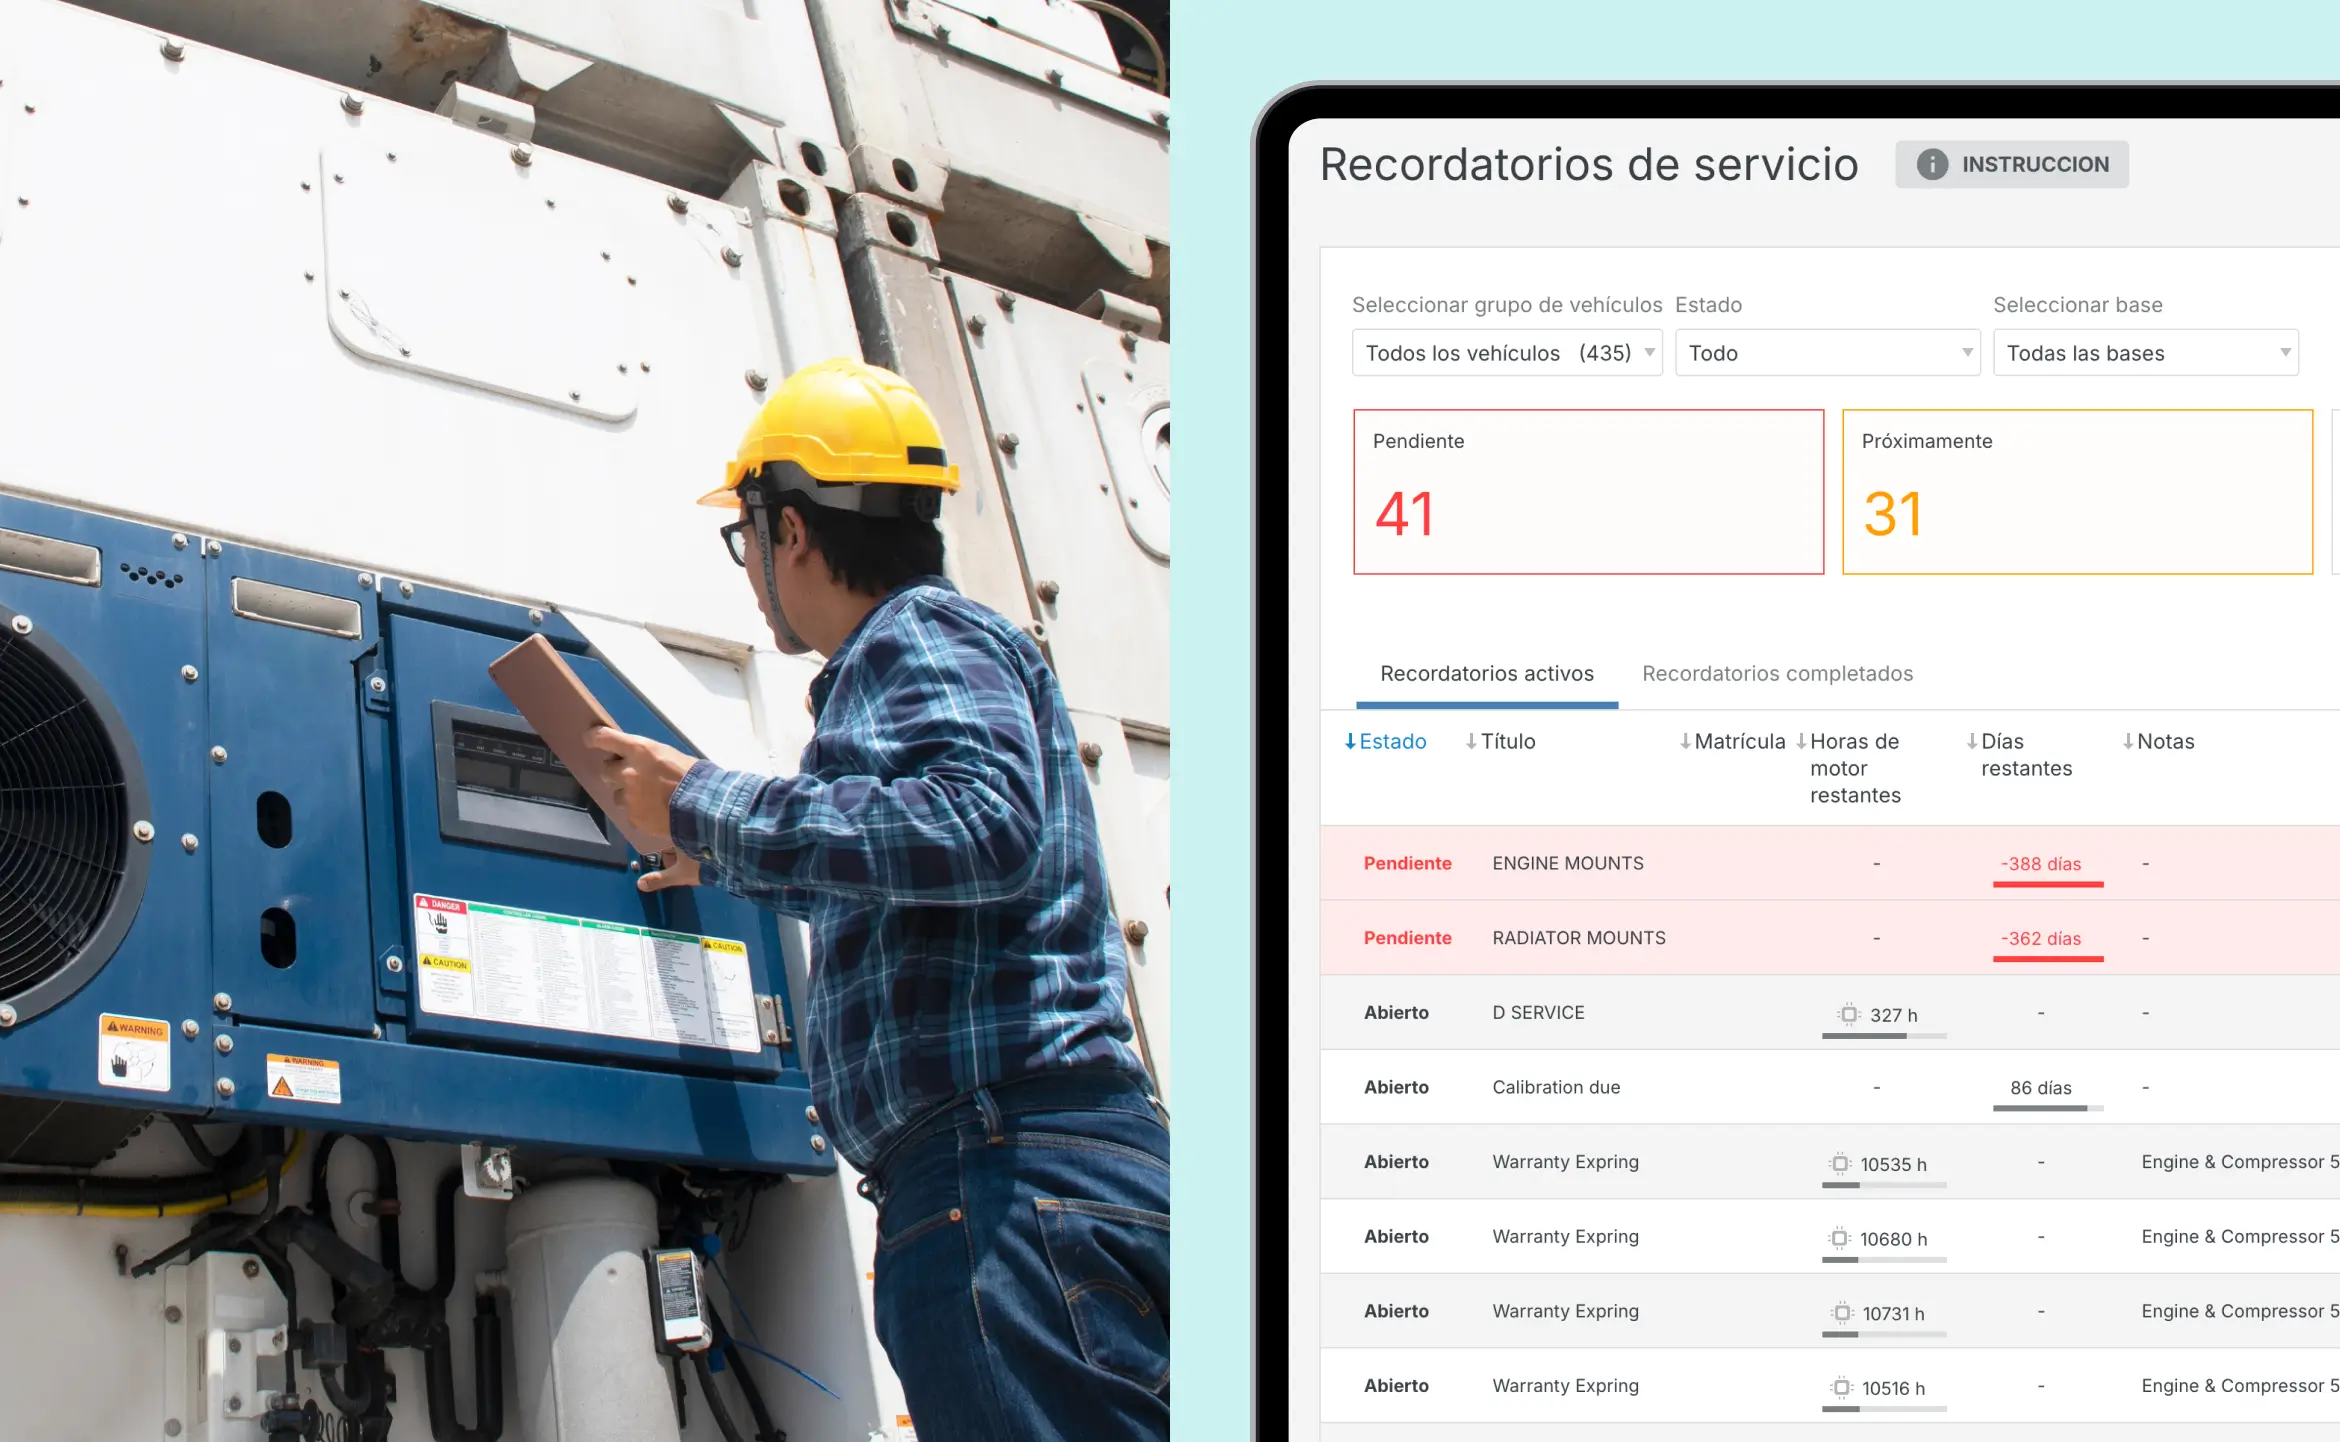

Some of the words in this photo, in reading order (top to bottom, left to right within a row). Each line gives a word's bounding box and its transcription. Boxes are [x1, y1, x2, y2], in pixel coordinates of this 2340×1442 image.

[1322, 145, 1613, 182] Recordatorios
[1628, 146, 1680, 182] de
[1694, 145, 1859, 182] servicio
[1963, 155, 2110, 173] INSTRUCCION
[1352, 295, 1469, 314] Seleccionar
[1474, 299, 1533, 318] grupo
[1538, 296, 1564, 314] de
[1569, 295, 1663, 314] vehículos
[1675, 295, 1743, 314] Estado
[1993, 295, 2110, 314] Seleccionar
[2116, 296, 2163, 313] base
[1365, 344, 1426, 362] Todos
[1432, 344, 1461, 362] los
[1466, 343, 1561, 362] vehículos
[1579, 342, 1631, 364] (435)
[1688, 344, 1739, 362] Todo
[2006, 344, 2067, 362] Todas
[2073, 344, 2101, 362] las
[2106, 344, 2165, 362] bases
[1373, 432, 1465, 449] Pendiente
[1862, 432, 1993, 449] Próximamente
[1375, 491, 1431, 537] 41
[1864, 490, 1919, 537] 31
[1381, 664, 1518, 682] Recordatorios
[1524, 664, 1595, 682] activos
[1643, 664, 1780, 682] Recordatorios
[1786, 664, 1914, 686] completados
[1360, 732, 1427, 750] Estado
[1480, 732, 1536, 750] Título
[1695, 732, 1786, 750] Matrícula
[1811, 732, 1869, 750] Horas
[1875, 732, 1900, 750] de
[1982, 732, 2024, 750] Días
[2138, 732, 2195, 750] Notas
[1811, 760, 1869, 777] motor
[1982, 760, 2073, 777] restantes
[1811, 787, 1902, 804] restantes
[1364, 855, 1453, 871] Pendiente
[1493, 855, 1559, 871] ENGINE
[1565, 855, 1644, 871] MOUNTS
[2001, 856, 2042, 872] -388
[2047, 855, 2082, 872] días
[431, 900, 461, 912] DANGER
[1364, 929, 1453, 946] Pendiente
[1493, 930, 1582, 946] RADIATOR
[1587, 930, 1666, 946] MOUNTS
[2001, 930, 2042, 946] -362
[2047, 930, 2082, 946] días
[713, 942, 743, 953] CAUTION
[433, 957, 467, 970] CAUTION
[1363, 1004, 1430, 1020] Abierto
[1493, 1004, 1506, 1020] D
[1511, 1004, 1585, 1020] SERVICE
[1870, 1007, 1903, 1023] 327
[1908, 1007, 1918, 1023] h
[119, 1023, 163, 1036] WARNING
[291, 1057, 324, 1067] WARNING
[1363, 1079, 1430, 1095] Abierto
[1492, 1079, 1584, 1095] Calibration
[1589, 1079, 1621, 1095] due
[2010, 1080, 2033, 1096] 86
[2037, 1079, 2073, 1096] días
[1363, 1153, 1430, 1170] Abierto
[1492, 1154, 1571, 1173] Warranty
[1576, 1153, 1639, 1173] Expring
[1861, 1156, 1912, 1172] 10535
[1917, 1157, 1927, 1172] h
[2142, 1153, 2200, 1173] Engine
[2204, 1154, 2216, 1169] &
[2221, 1154, 2326, 1173] Compressor
[1363, 1228, 1430, 1244] Abierto
[1492, 1228, 1571, 1248] Warranty
[1575, 1228, 1639, 1248] Expring
[1860, 1231, 1912, 1247] 10680
[1917, 1231, 1928, 1247] h
[2142, 1228, 2200, 1248] Engine
[2204, 1228, 2216, 1244] &
[2221, 1228, 2326, 1248] Compressor
[1363, 1303, 1430, 1319] Abierto
[1492, 1303, 1571, 1322] Warranty
[1575, 1303, 1639, 1322] Expring
[1863, 1306, 1909, 1322] 10731
[1915, 1306, 1925, 1321] h
[2142, 1303, 2200, 1322] Engine
[2204, 1303, 2216, 1319] &
[2221, 1303, 2325, 1322] Compressor
[1363, 1377, 1430, 1393] Abierto
[1492, 1378, 1571, 1397] Warranty
[1576, 1377, 1639, 1397] Expring
[1862, 1380, 1910, 1396] 10516
[1915, 1381, 1926, 1396] h
[2142, 1377, 2200, 1397] Engine
[2204, 1378, 2217, 1393] &
[2221, 1377, 2326, 1397] Compressor
